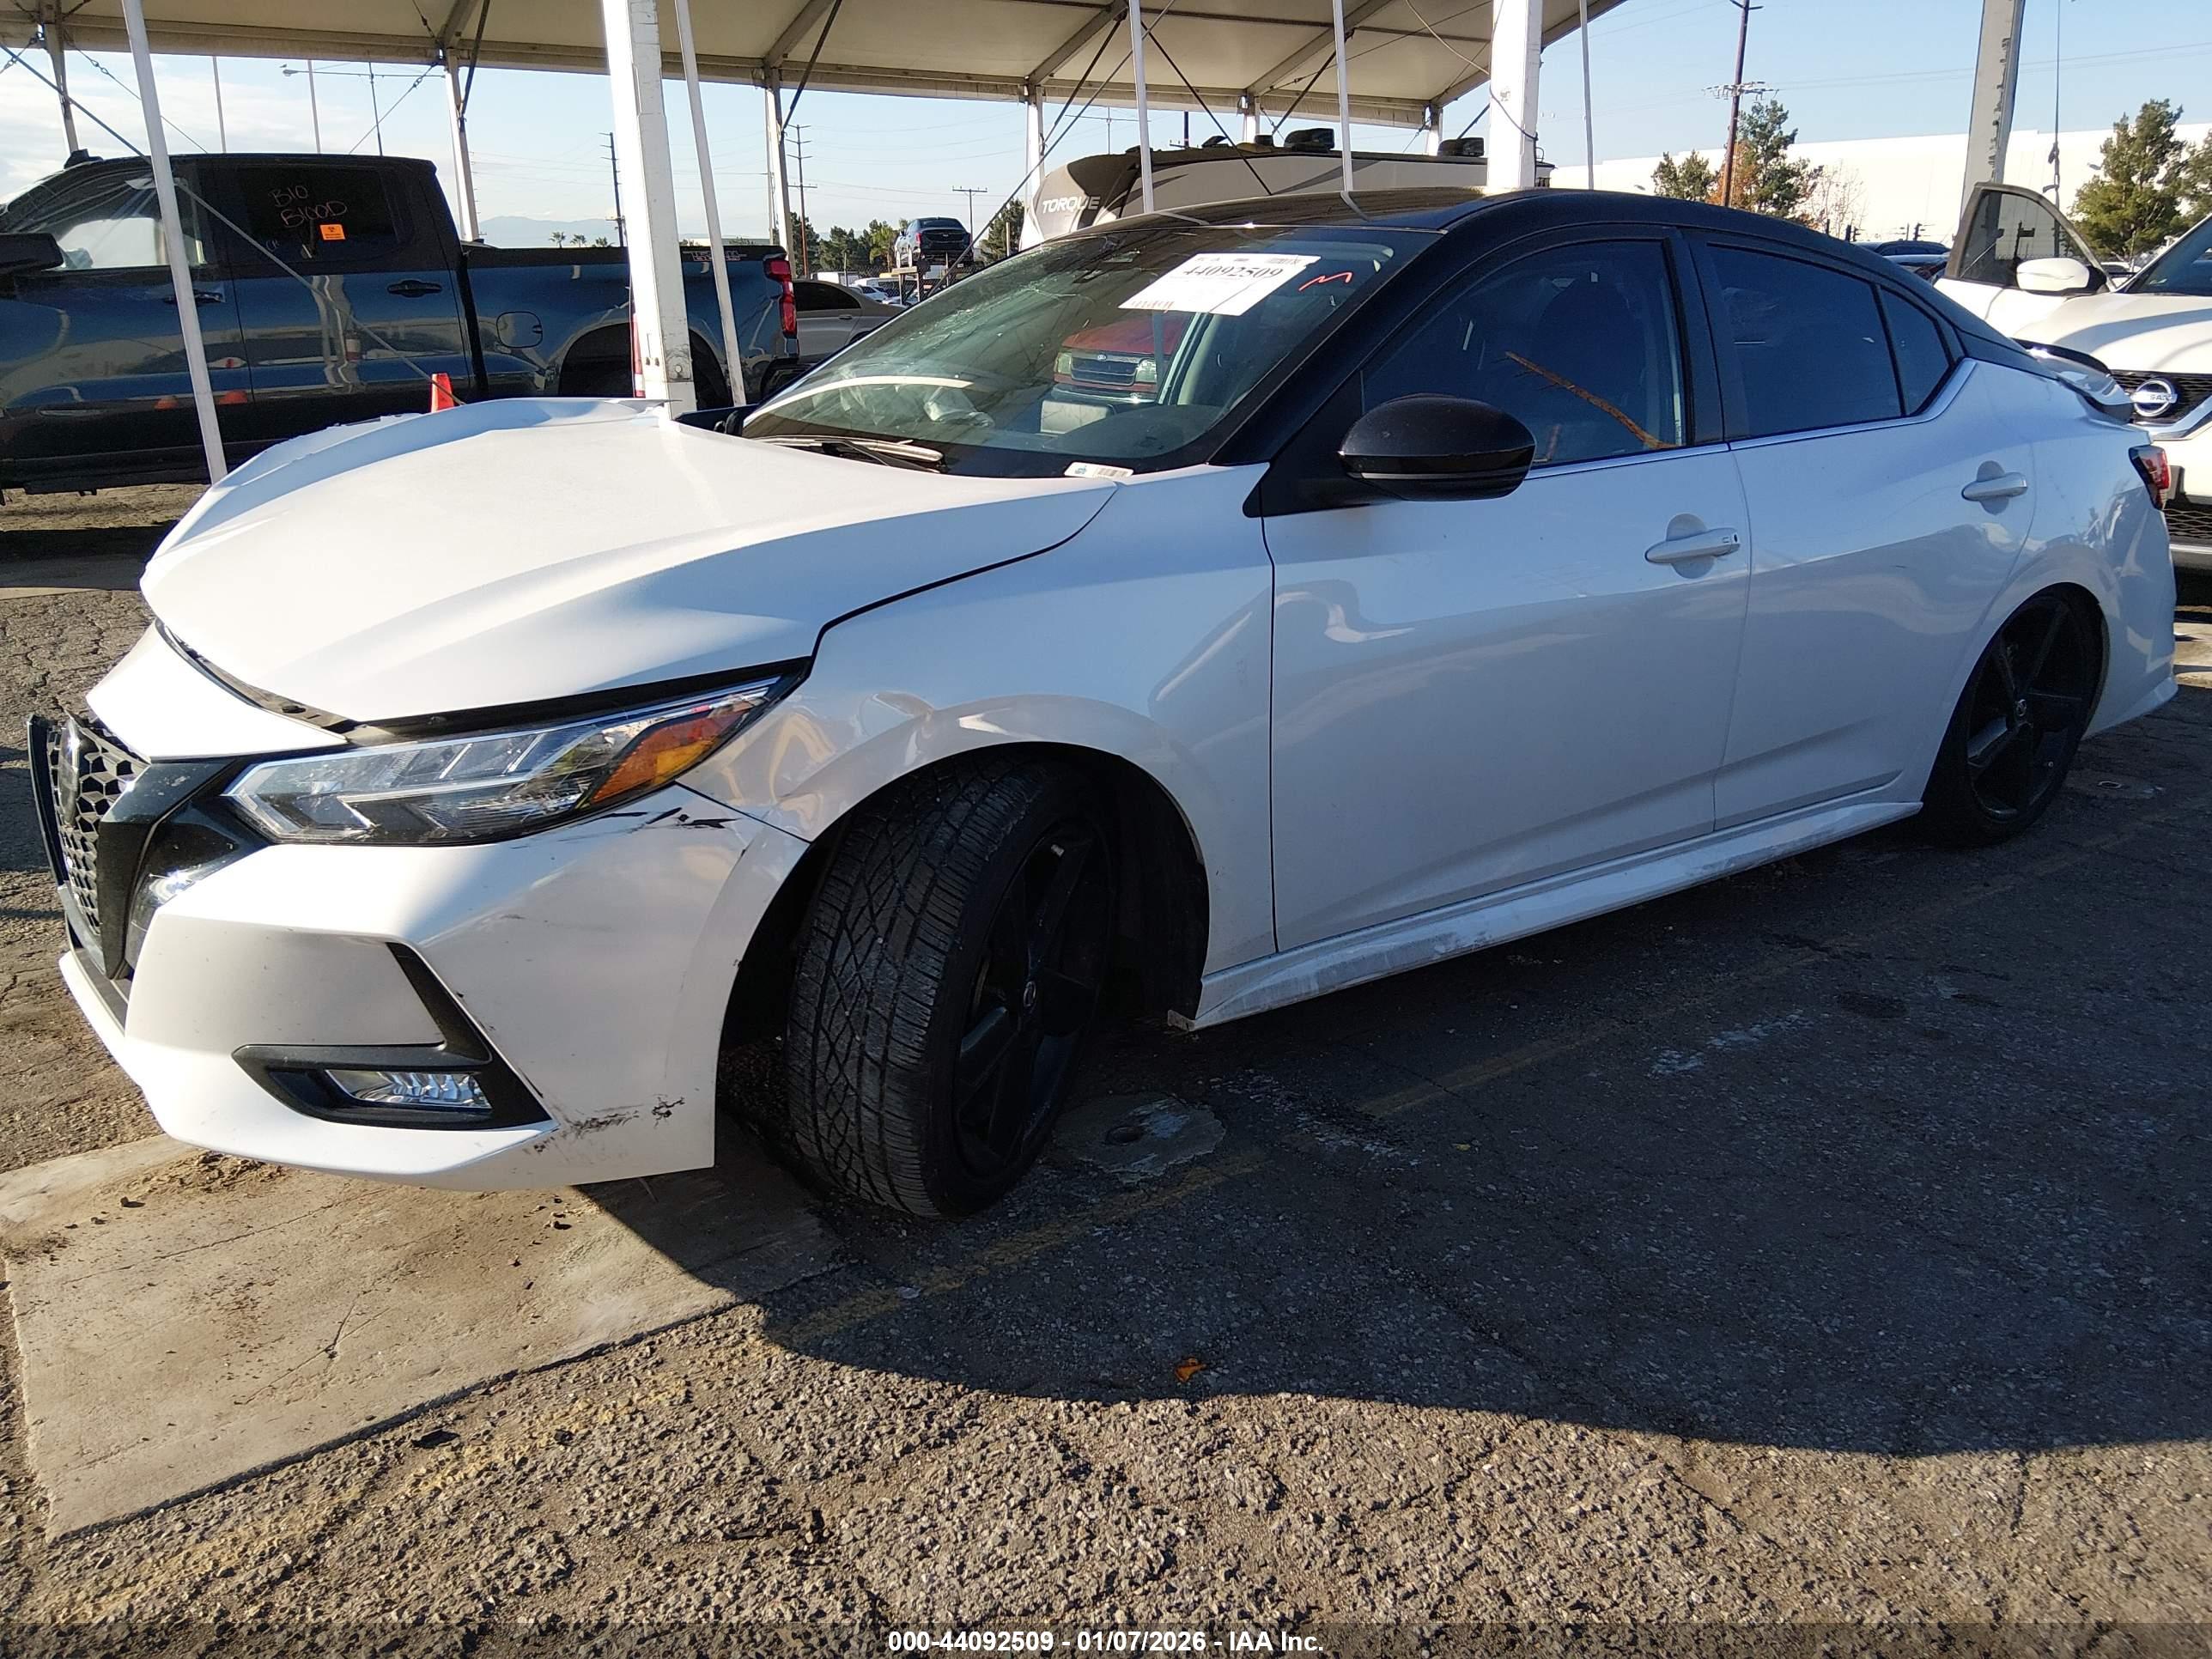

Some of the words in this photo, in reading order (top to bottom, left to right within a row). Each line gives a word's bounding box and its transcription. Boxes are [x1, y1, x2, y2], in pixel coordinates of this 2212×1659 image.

[268, 185, 309, 208] BIO
[1042, 195, 1102, 214] TORQUE
[1183, 265, 1285, 280] 44092509
